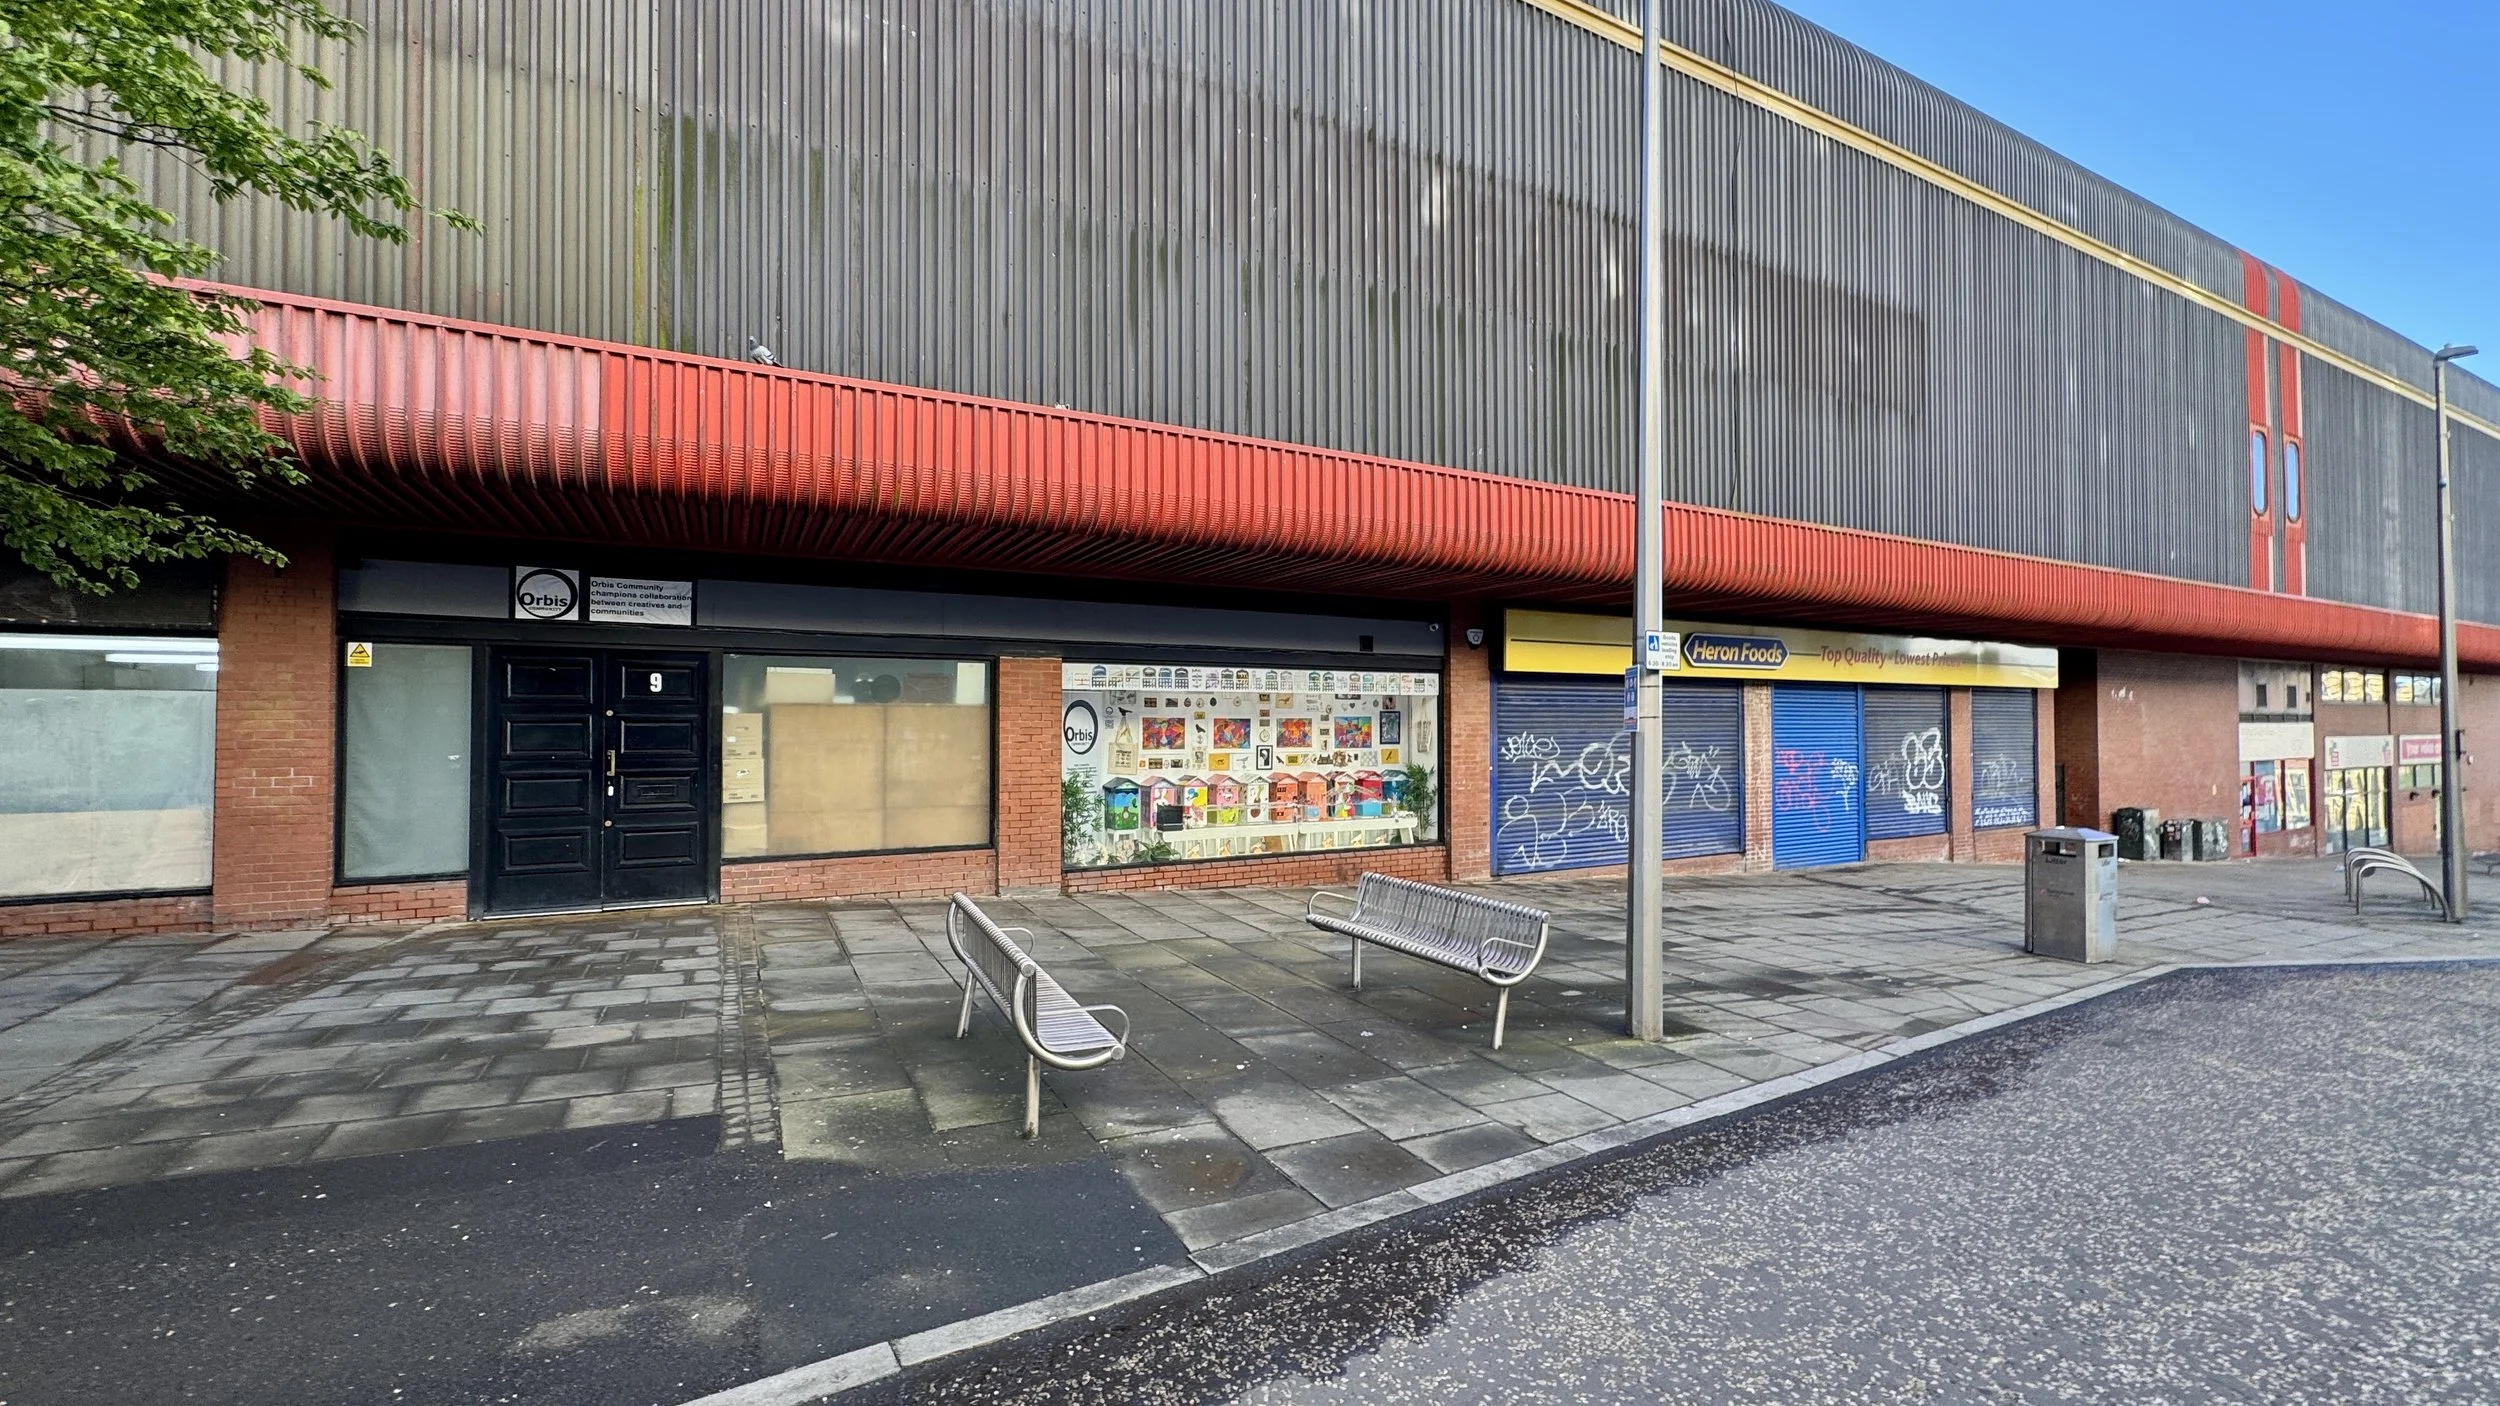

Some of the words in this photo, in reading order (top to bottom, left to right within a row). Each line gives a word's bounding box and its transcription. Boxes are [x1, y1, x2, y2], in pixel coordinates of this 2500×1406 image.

[591, 580, 614, 589] Orbis
[617, 582, 664, 592] Community
[520, 592, 568, 607] Orbis
[591, 590, 637, 599] champions
[639, 592, 692, 601] collaboration
[591, 599, 626, 607] between
[628, 601, 665, 609] creatives
[667, 602, 683, 610] and
[590, 608, 644, 617] communities
[1692, 639, 1738, 661] Heron
[1740, 642, 1783, 663] Foods
[1820, 646, 1841, 667] Top
[1844, 647, 1887, 668] Quality
[1894, 650, 1931, 666] Lowest
[650, 672, 662, 692] 9
[1065, 726, 1093, 741] Orbis
